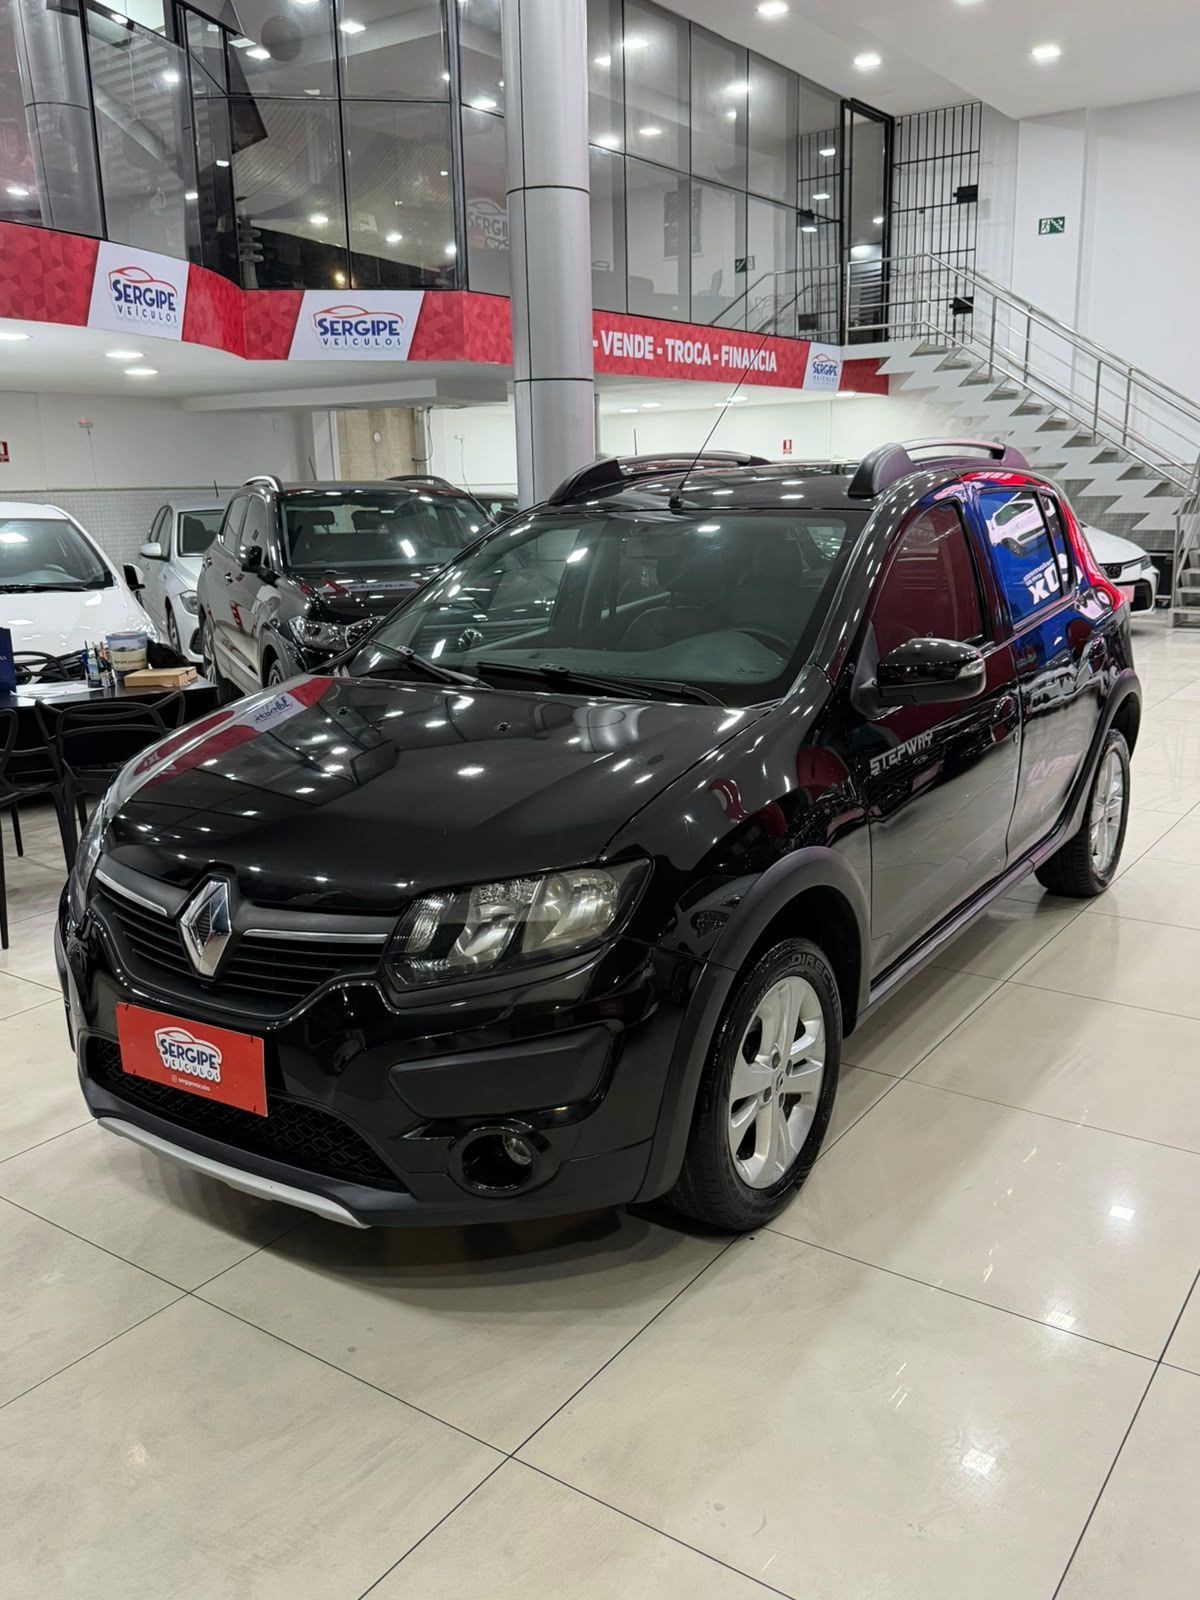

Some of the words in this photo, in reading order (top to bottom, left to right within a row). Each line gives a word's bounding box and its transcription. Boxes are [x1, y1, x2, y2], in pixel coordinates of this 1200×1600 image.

[112, 279, 177, 312] SERGIPE
[317, 318, 401, 337] SERGIPE
[601, 330, 655, 360] VENDE
[665, 338, 712, 366] TROCA
[721, 345, 777, 372] FINANCIA
[869, 729, 934, 777] STEPWAY
[159, 1038, 218, 1070] SERGIPE
